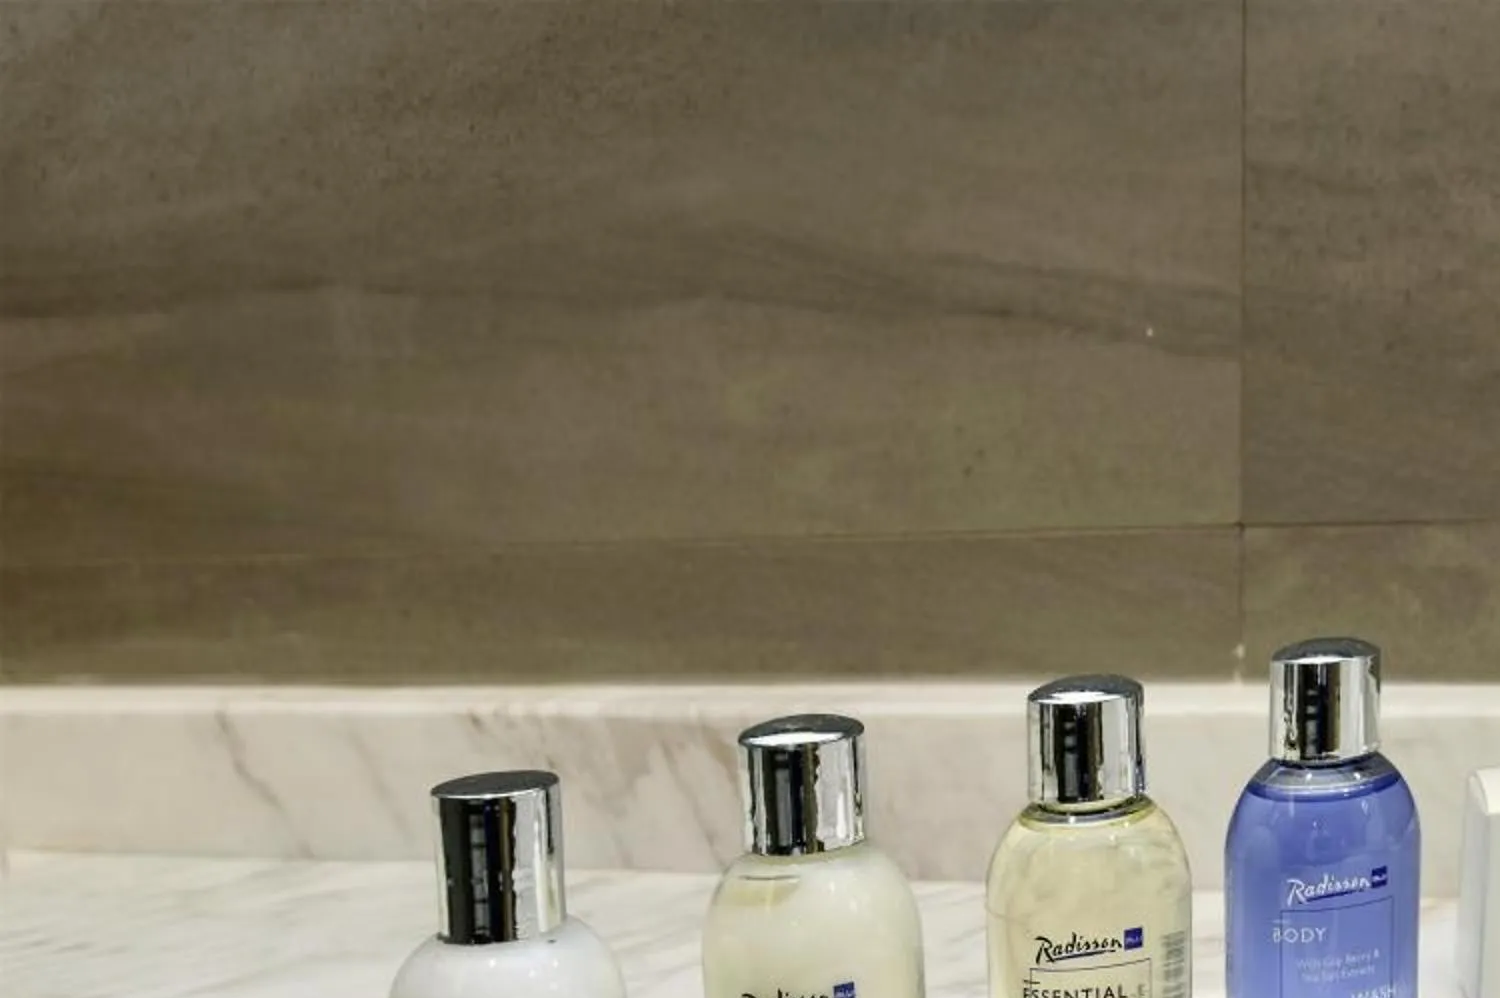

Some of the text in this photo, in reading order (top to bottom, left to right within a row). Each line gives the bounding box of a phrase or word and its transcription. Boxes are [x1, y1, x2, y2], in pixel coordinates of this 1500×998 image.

[1286, 872, 1373, 907] Radisson
[1035, 931, 1123, 965] Radisson
[1272, 927, 1327, 944] BODY
